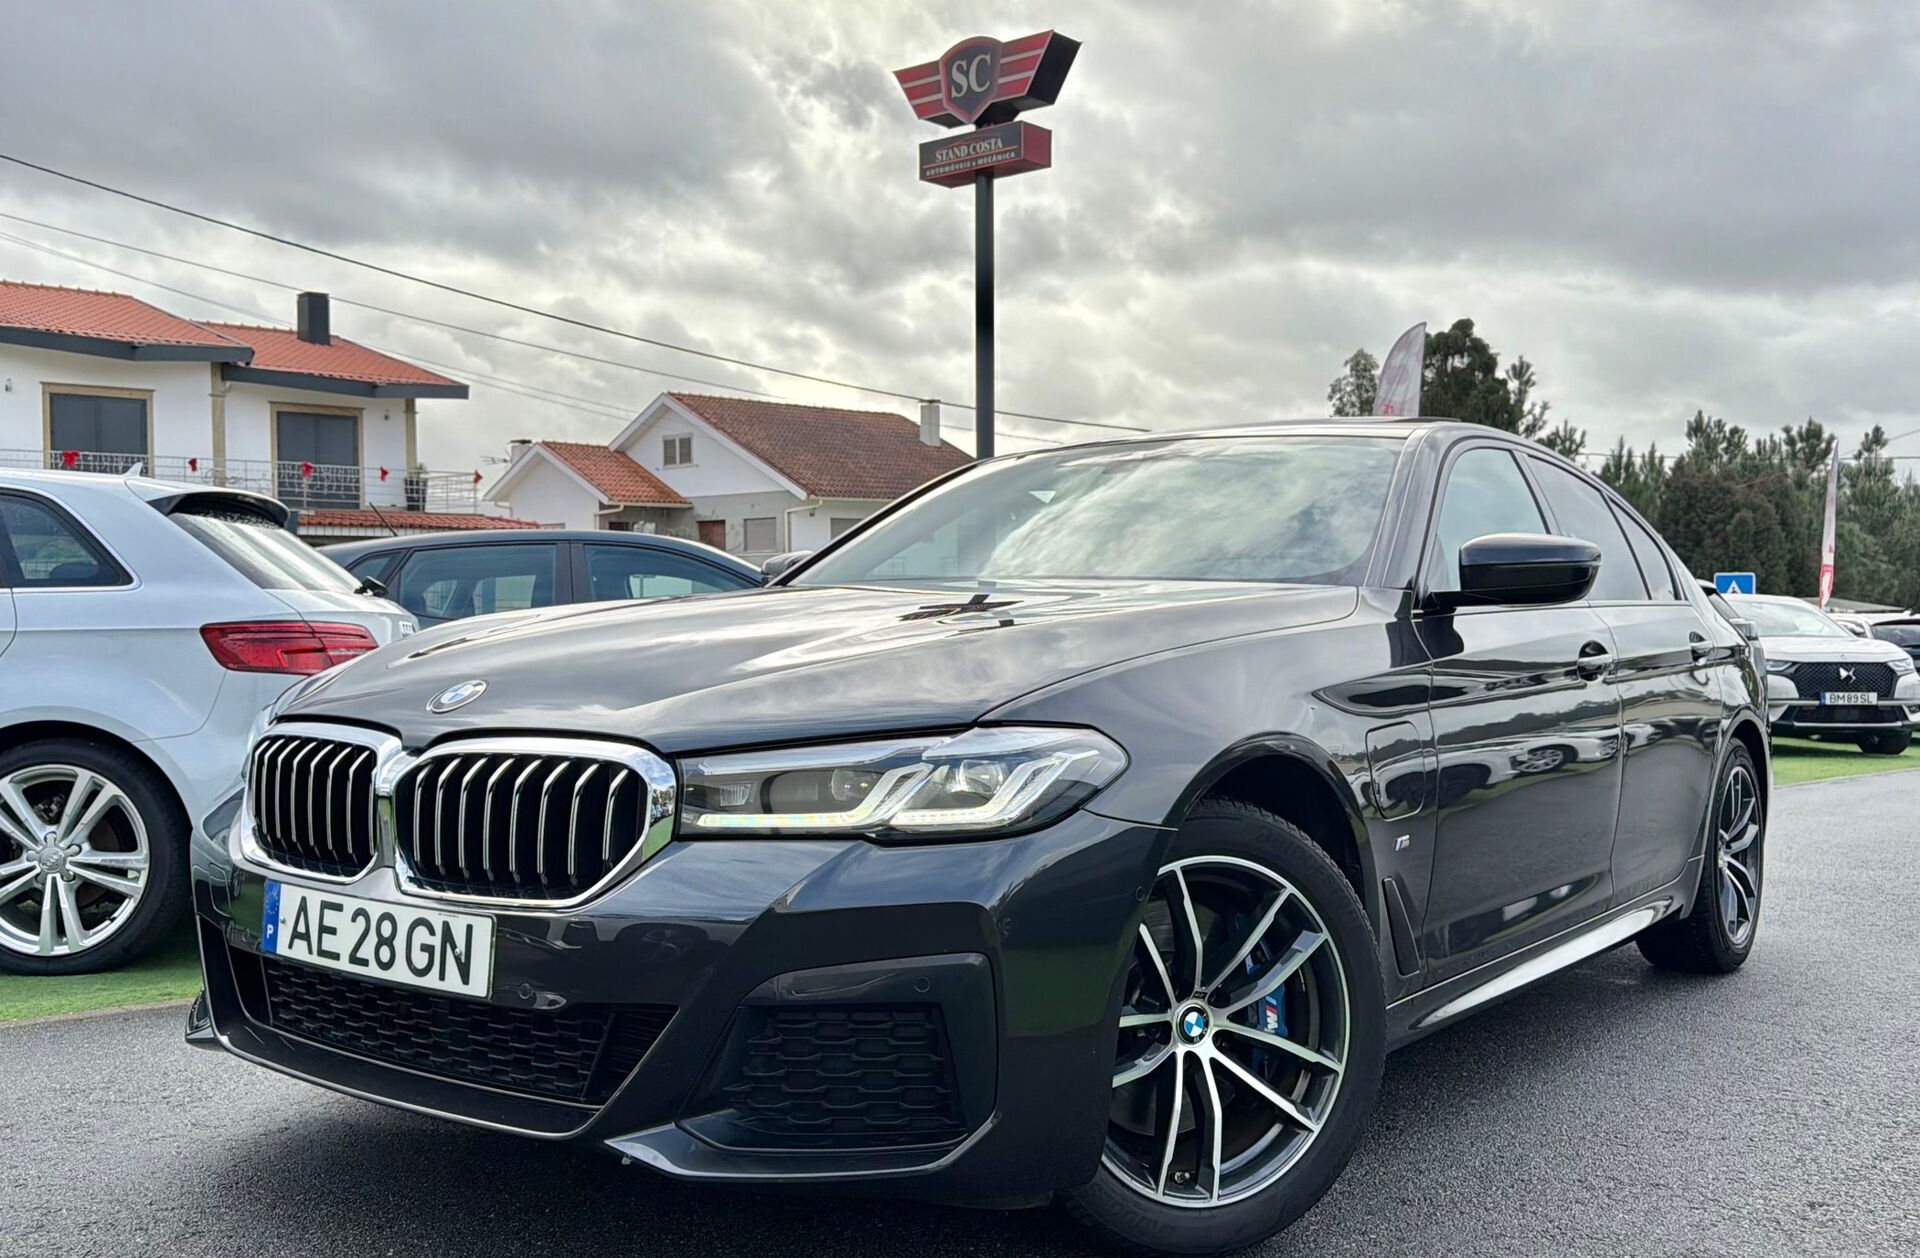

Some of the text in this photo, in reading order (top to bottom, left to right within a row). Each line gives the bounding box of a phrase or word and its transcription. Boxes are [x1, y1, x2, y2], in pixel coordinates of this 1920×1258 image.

[951, 53, 991, 98] SC
[935, 137, 1003, 162] STAND COSTA
[266, 924, 274, 939] P
